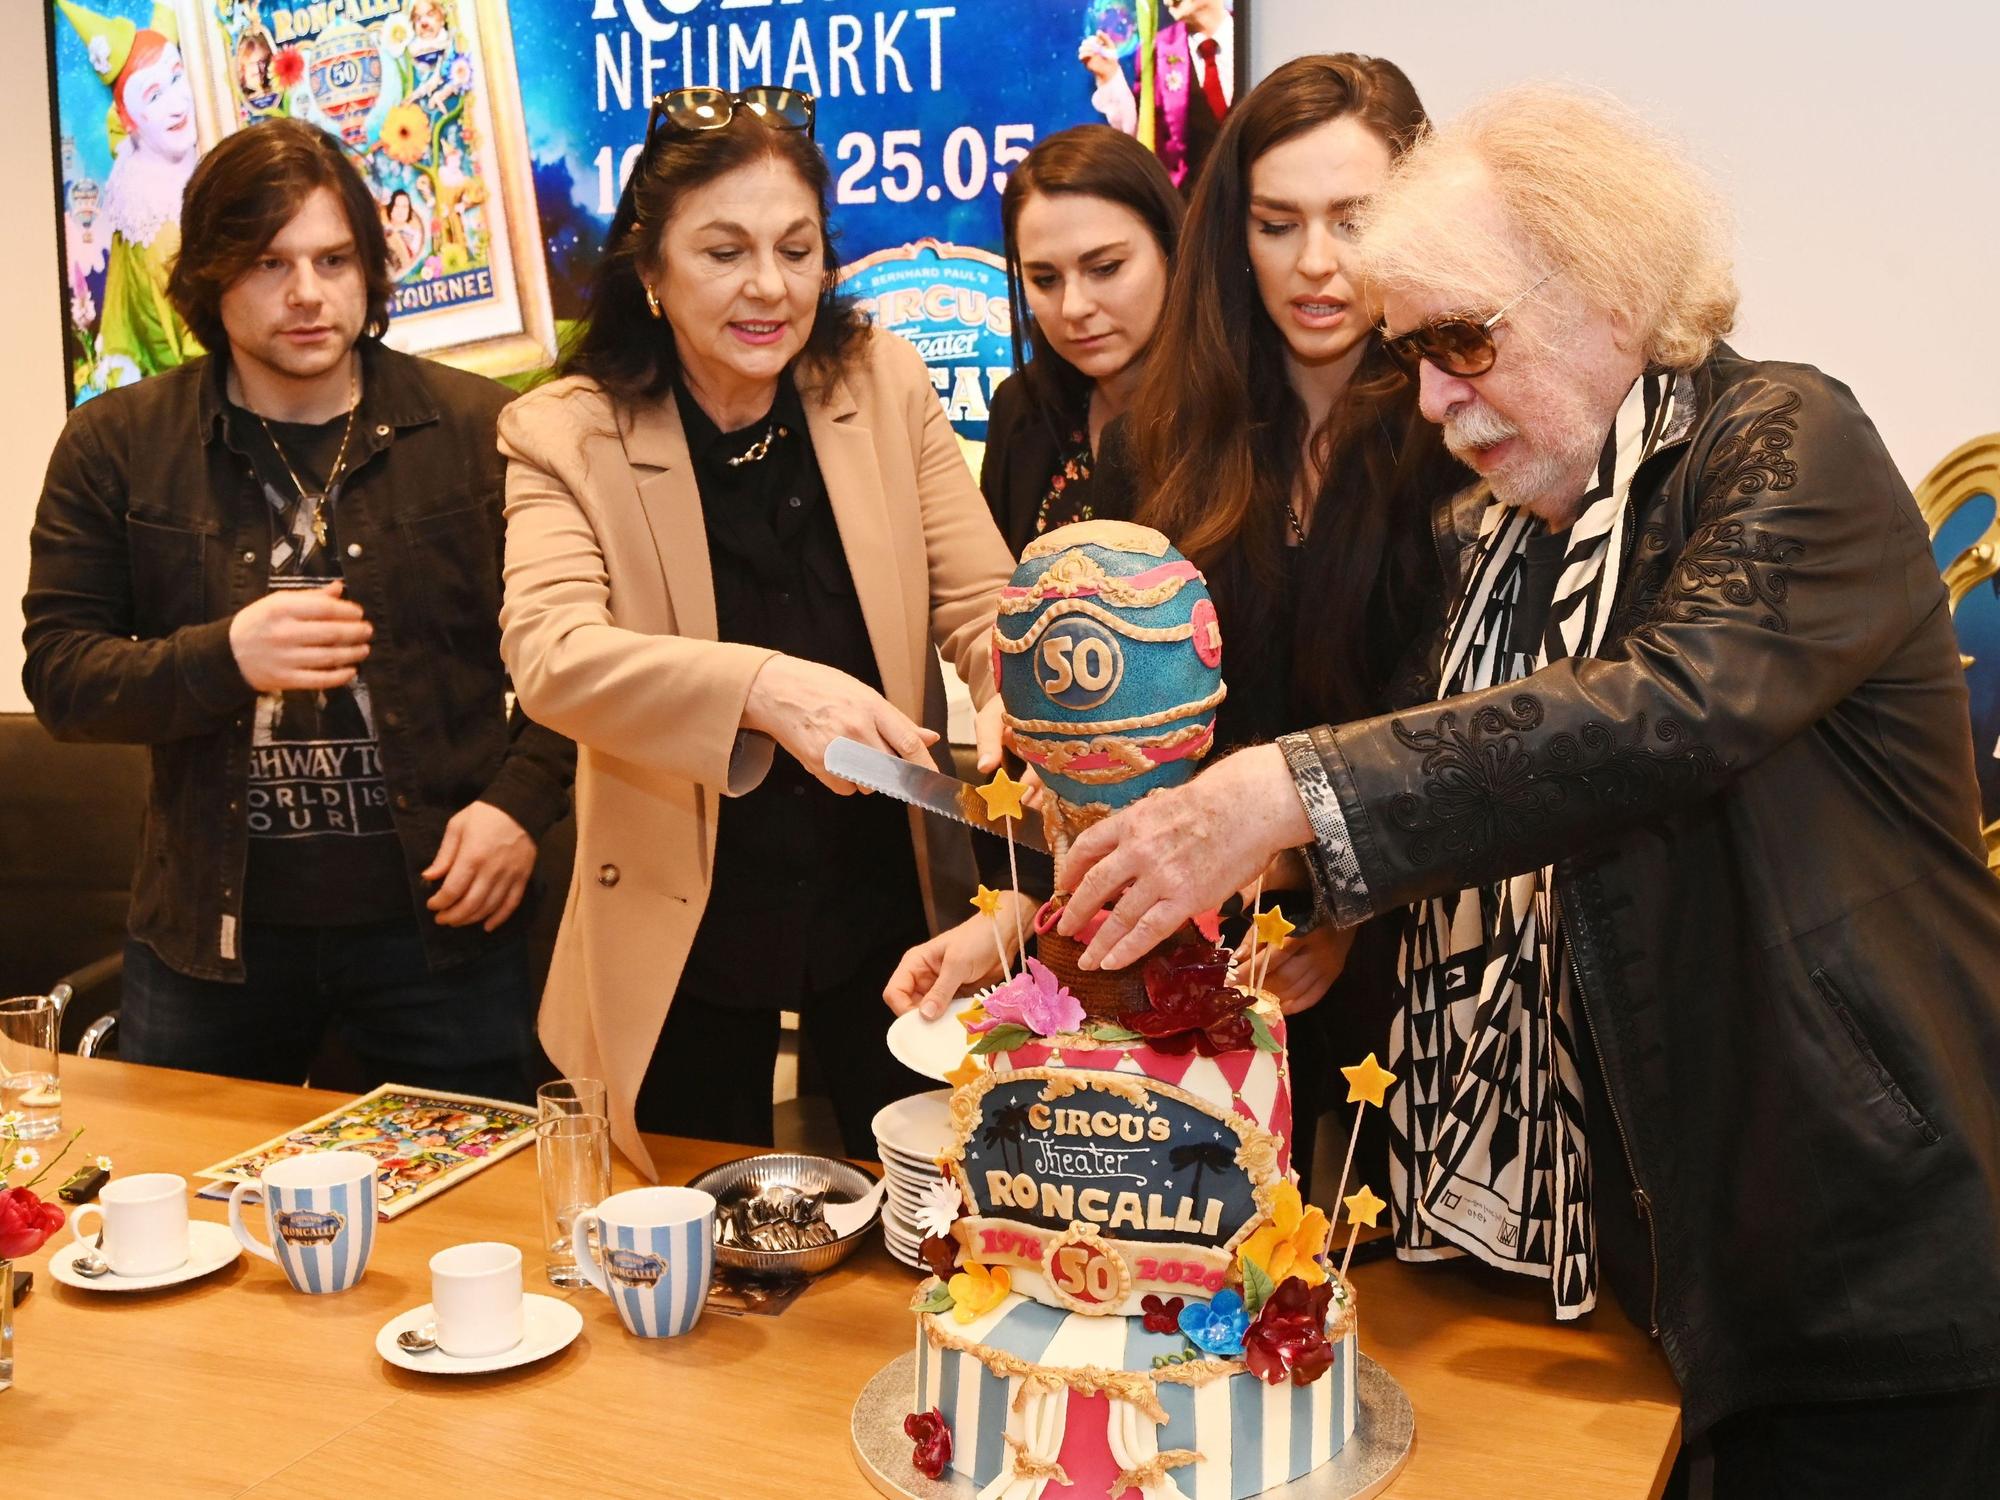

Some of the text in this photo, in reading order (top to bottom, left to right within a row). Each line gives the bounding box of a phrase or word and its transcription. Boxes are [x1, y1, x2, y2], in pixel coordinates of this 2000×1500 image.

[331, 63, 357, 86] 50
[595, 7, 957, 112] NEUMARKT
[871, 267, 990, 287] BERNHARD PAUL'S
[1043, 635, 1113, 694] 50
[1028, 1103, 1170, 1142] CIRCUS
[1027, 1137, 1132, 1179] Theater
[986, 1170, 1224, 1236] RONCALLI
[979, 1228, 1043, 1262] 1976
[1057, 1246, 1120, 1301] 50
